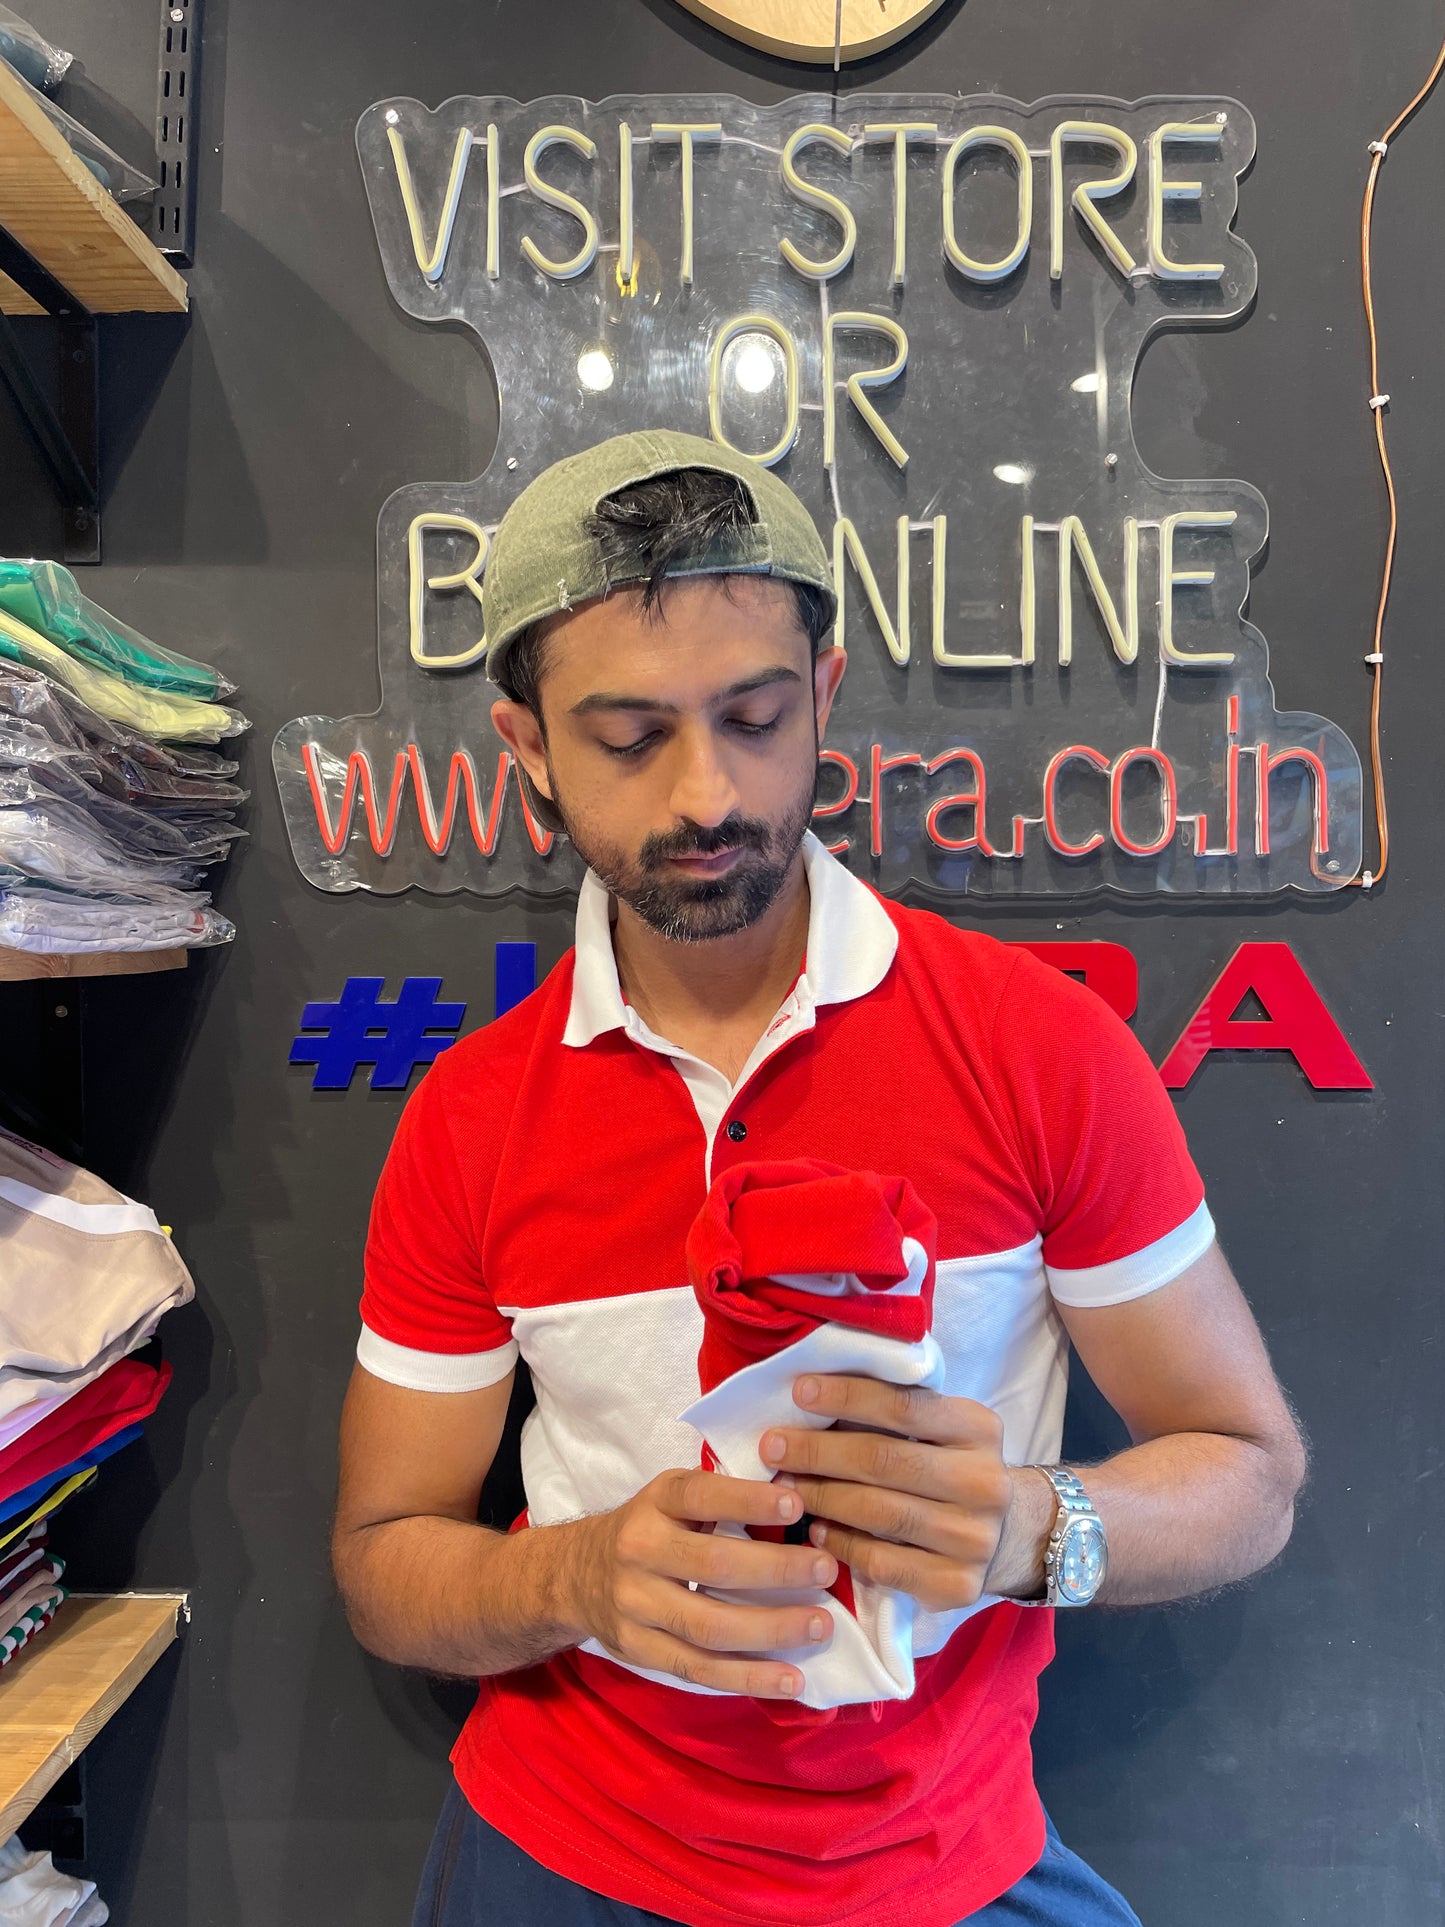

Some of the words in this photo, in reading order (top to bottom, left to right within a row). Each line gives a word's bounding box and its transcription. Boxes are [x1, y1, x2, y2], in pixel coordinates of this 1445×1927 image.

[386, 122, 723, 284] VISIT
[779, 120, 1225, 284] STORE
[710, 311, 910, 470] OR
[832, 510, 1238, 666] NLINE
